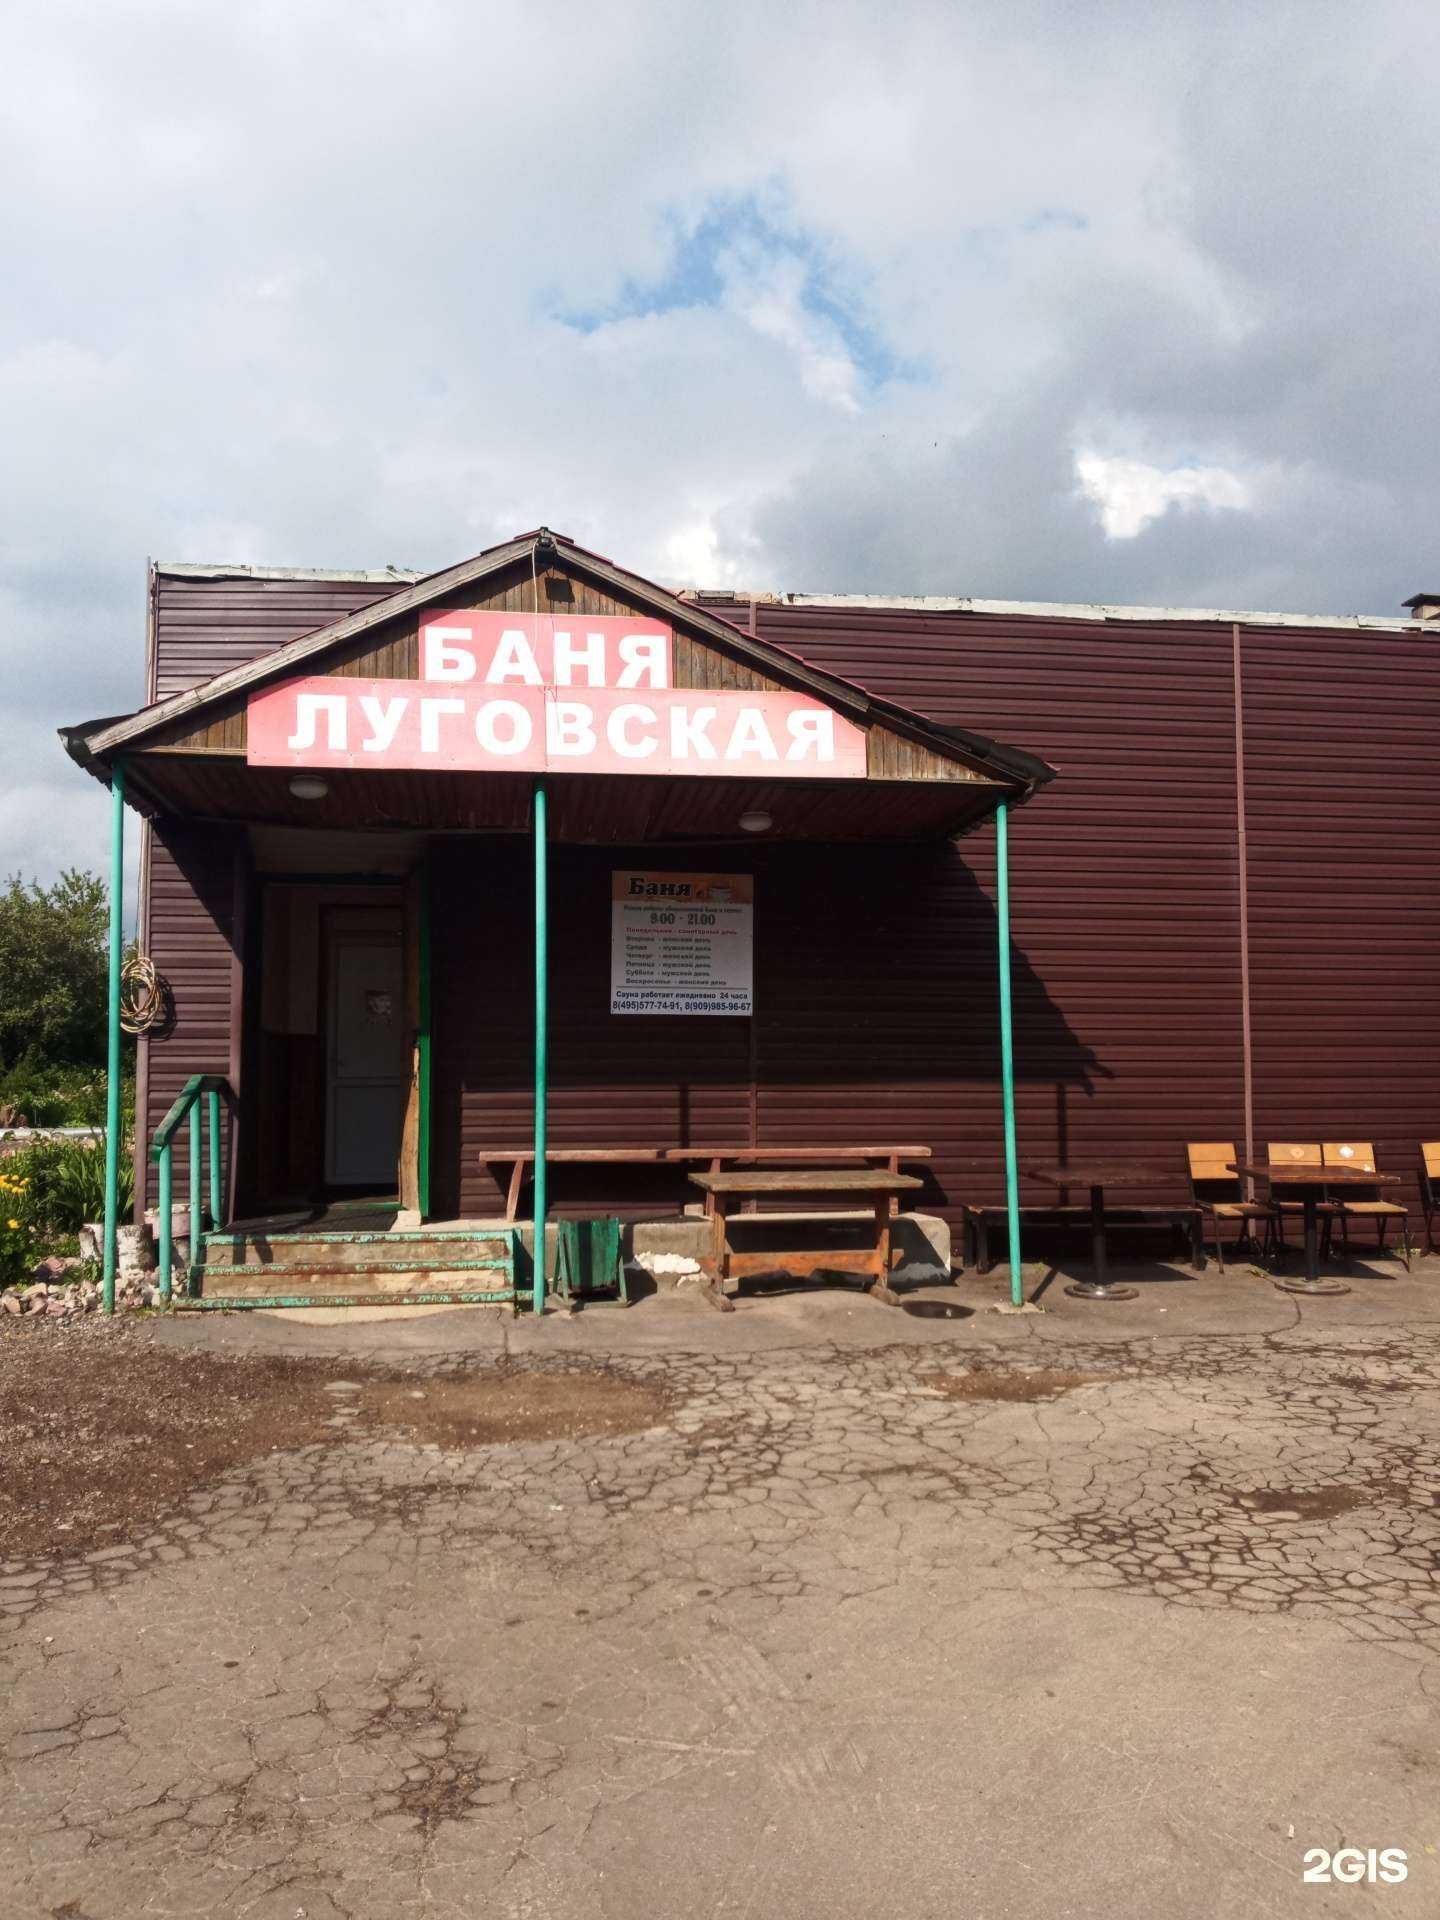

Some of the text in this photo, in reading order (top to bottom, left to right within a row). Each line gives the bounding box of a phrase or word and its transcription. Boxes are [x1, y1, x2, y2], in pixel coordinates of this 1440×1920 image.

[424, 626, 668, 689] БАНЯ
[287, 693, 834, 762] ЛУГОВСКАЯ
[628, 877, 692, 897] Баня
[616, 990, 639, 999] Сауна
[640, 991, 673, 999] работает
